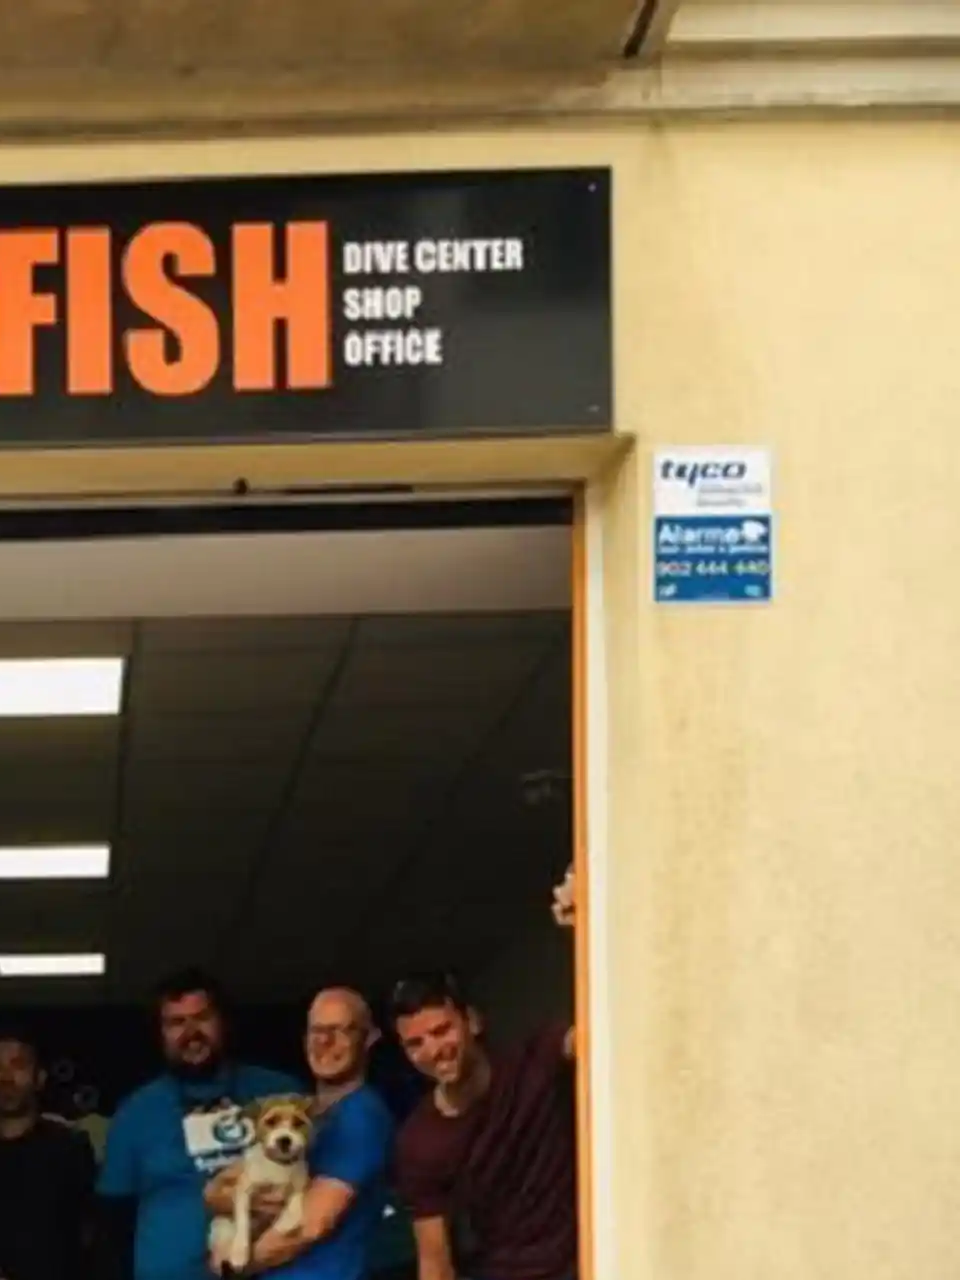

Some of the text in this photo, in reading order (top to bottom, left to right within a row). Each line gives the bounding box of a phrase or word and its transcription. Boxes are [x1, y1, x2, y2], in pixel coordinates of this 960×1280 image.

[343, 238, 523, 274] DIVE CENTER
[343, 287, 422, 320] SHOP
[344, 329, 443, 366] OFFICE
[660, 460, 747, 488] tyco
